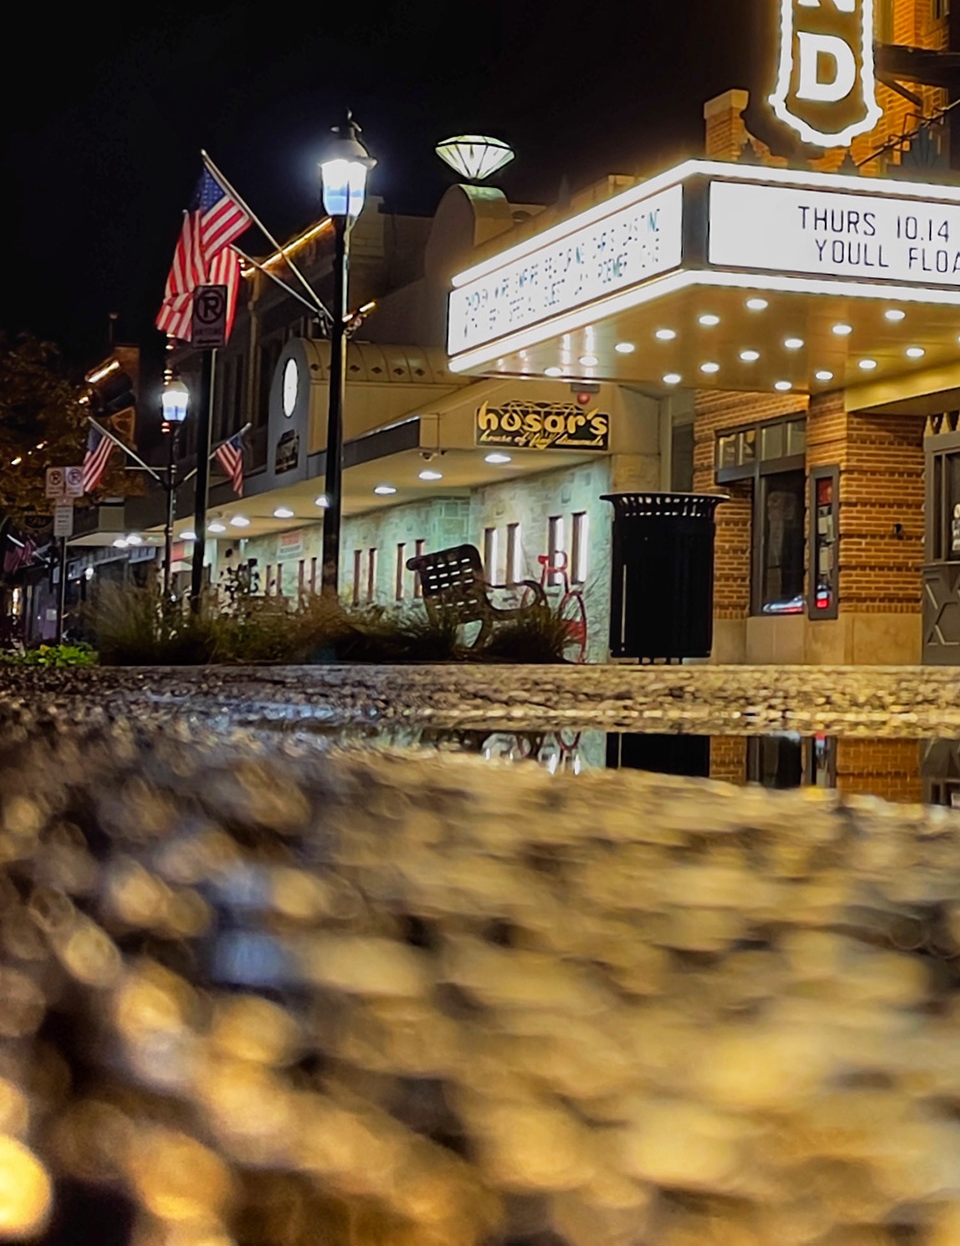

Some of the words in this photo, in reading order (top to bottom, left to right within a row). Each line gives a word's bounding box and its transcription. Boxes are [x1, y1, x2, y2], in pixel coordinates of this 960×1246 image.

[798, 205, 876, 237] THURS
[896, 214, 950, 243] 10.14
[814, 239, 890, 268] YOULL
